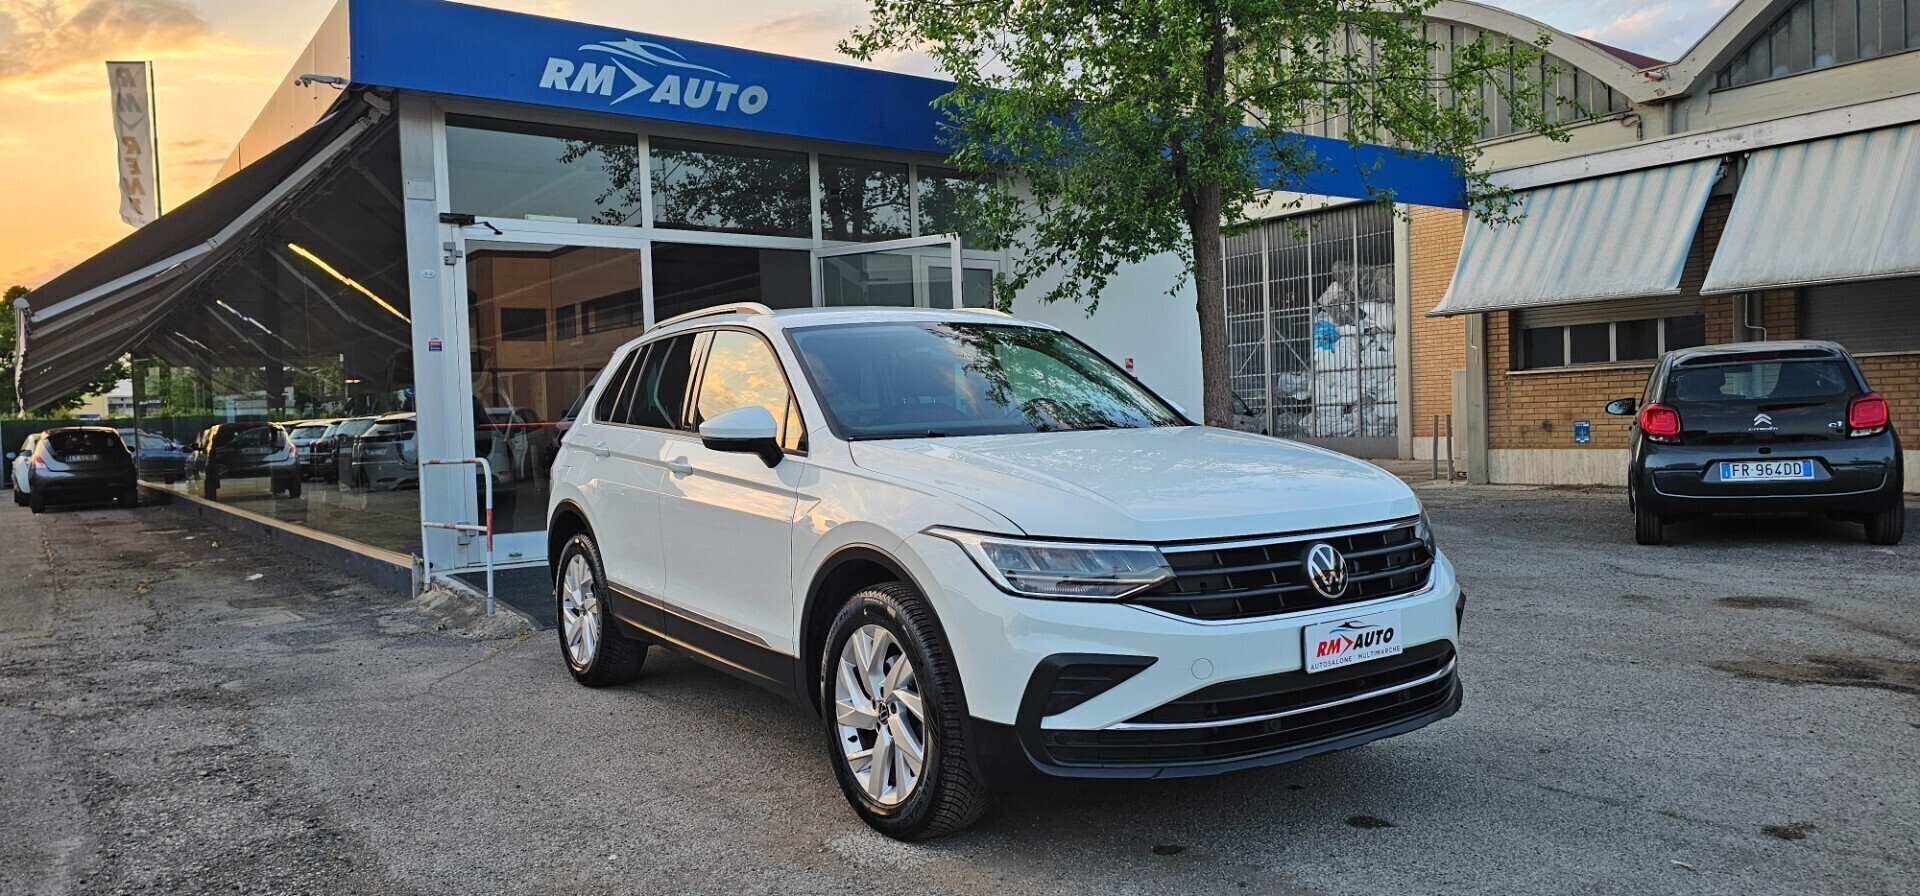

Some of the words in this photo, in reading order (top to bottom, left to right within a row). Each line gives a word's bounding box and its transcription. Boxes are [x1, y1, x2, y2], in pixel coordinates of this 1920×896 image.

[539, 57, 616, 97] RM
[648, 74, 769, 115] AUTO
[1311, 655, 1353, 670] AUTOSALONE
[1357, 645, 1400, 660] MULTIMARCHE
[1316, 637, 1341, 658] RM
[1353, 627, 1394, 650] AUTO
